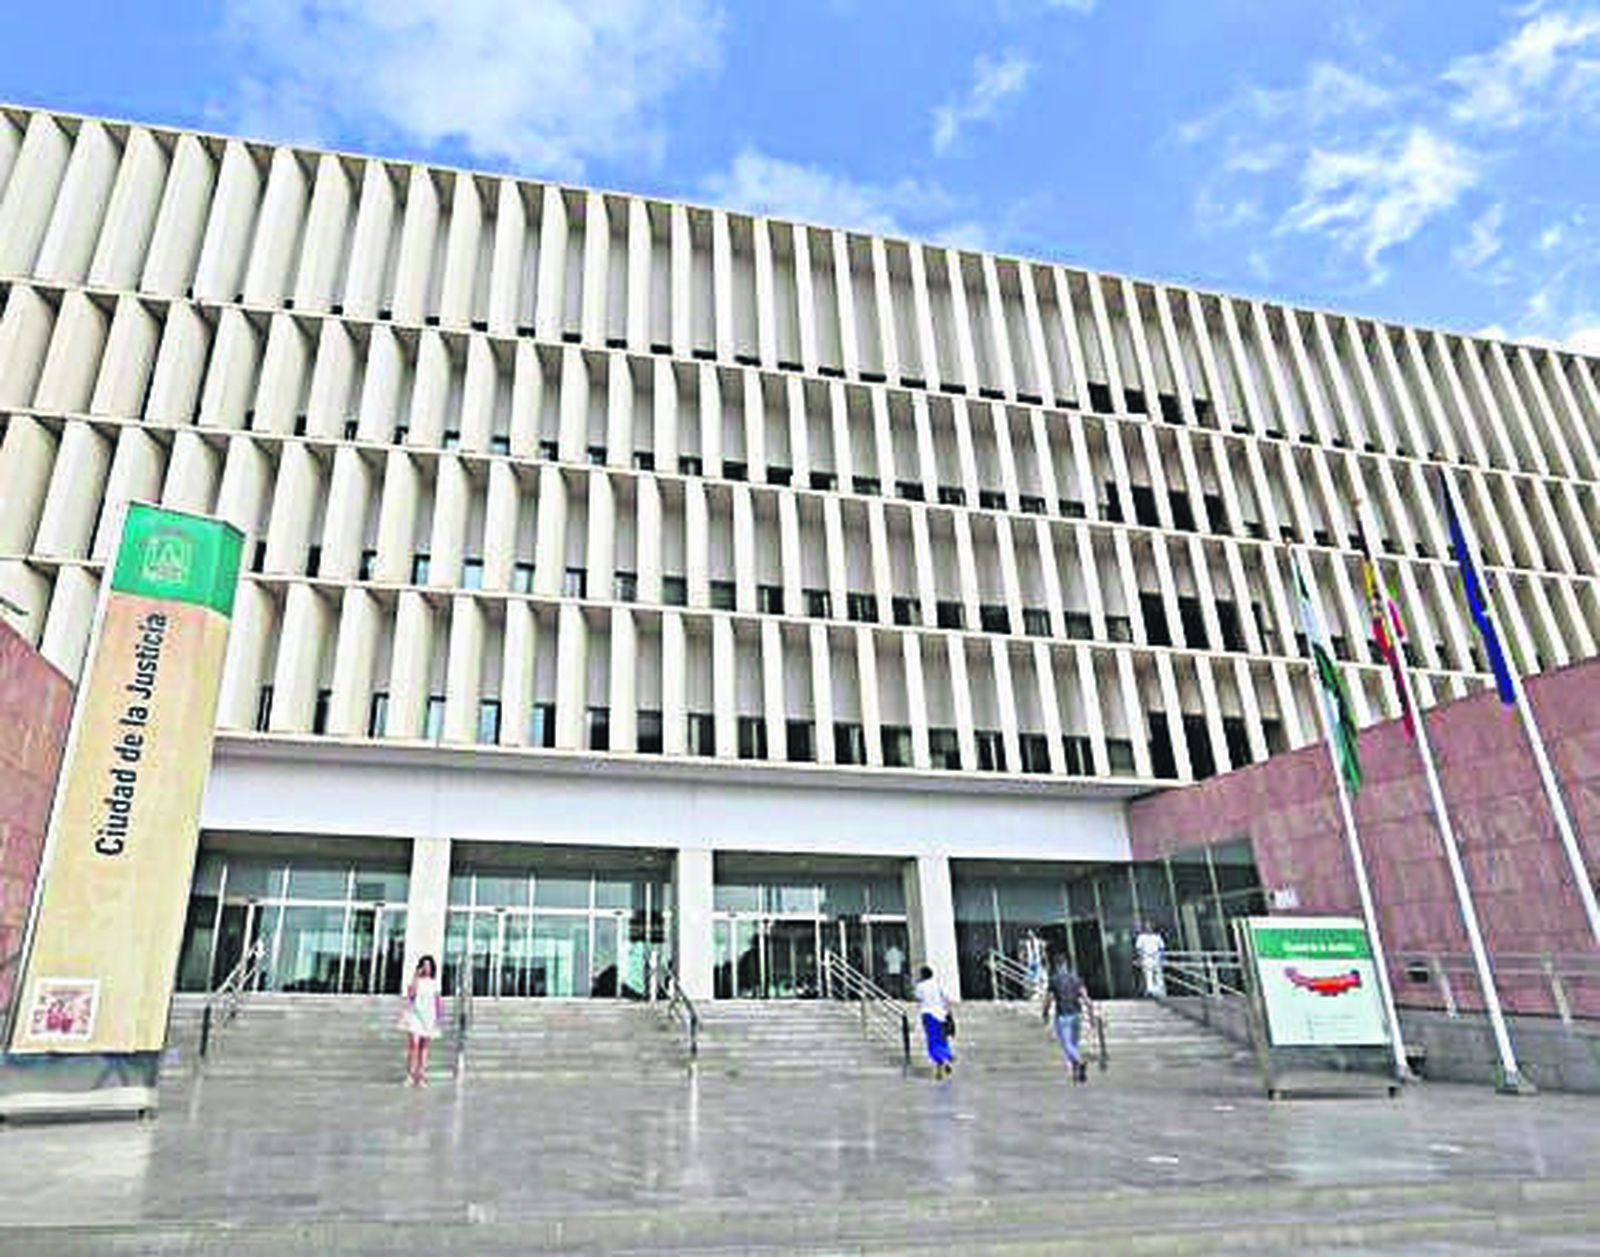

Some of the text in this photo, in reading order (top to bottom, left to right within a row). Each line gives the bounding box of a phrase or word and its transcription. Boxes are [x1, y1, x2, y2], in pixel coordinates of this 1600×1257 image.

[95, 613, 167, 855] Ciudad de la Justicia
